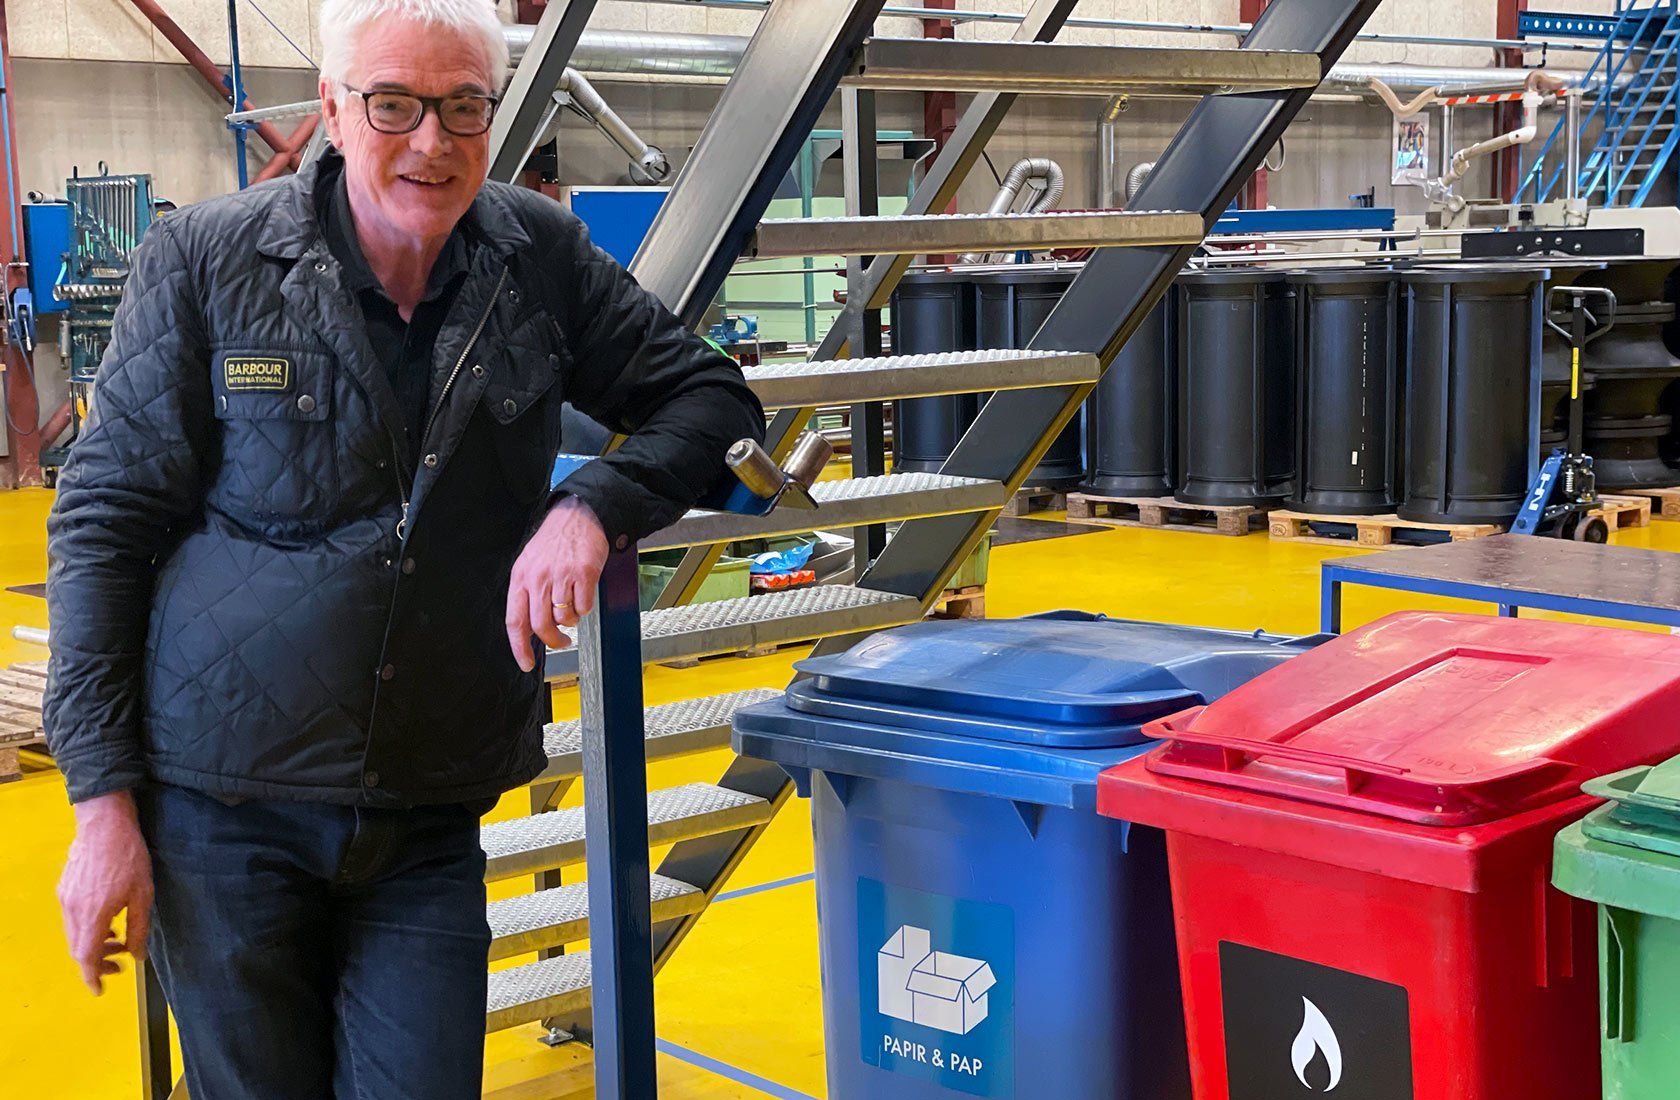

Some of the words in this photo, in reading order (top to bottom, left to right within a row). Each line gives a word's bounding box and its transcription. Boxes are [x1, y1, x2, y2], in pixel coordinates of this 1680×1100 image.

[228, 363, 282, 376] BARBOUR
[228, 376, 283, 384] INTERNATIONAL
[884, 1034, 927, 1064] PAPIR
[931, 1048, 945, 1068] &
[950, 1053, 983, 1077] PAP
